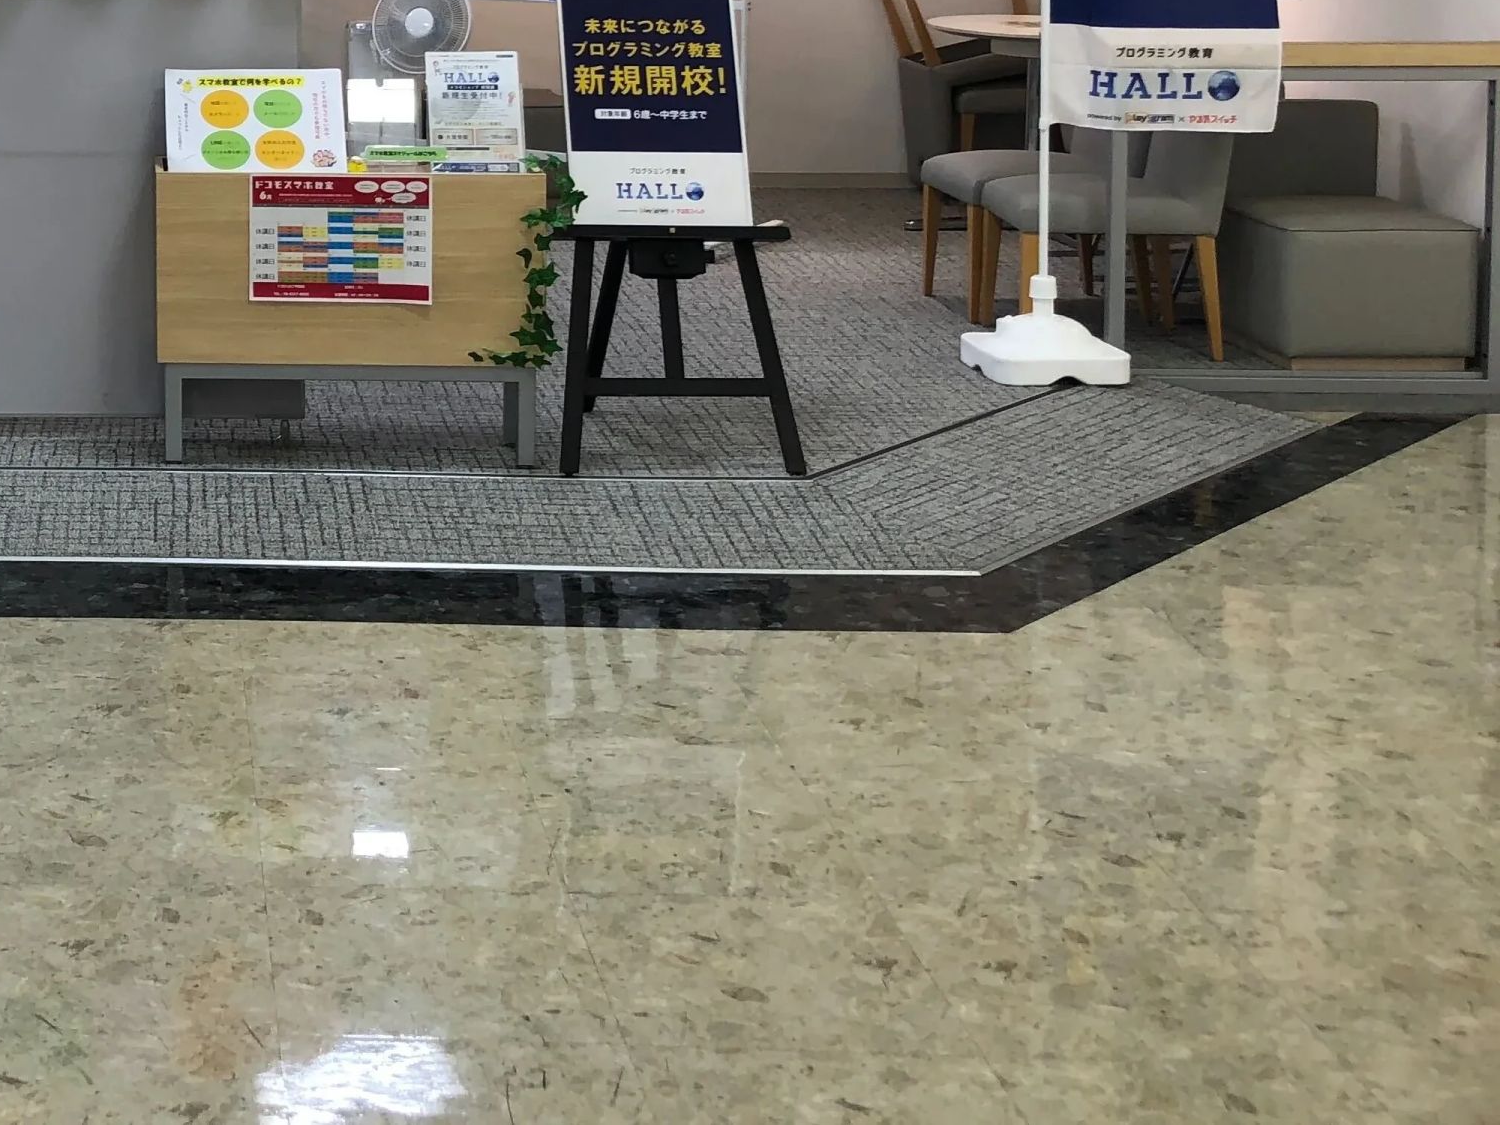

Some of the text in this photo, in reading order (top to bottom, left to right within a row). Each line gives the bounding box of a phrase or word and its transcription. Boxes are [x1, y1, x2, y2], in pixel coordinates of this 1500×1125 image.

[584, 19, 706, 35] 未来につながる
[572, 41, 722, 58] プログラミング教室
[1115, 47, 1214, 59] プログラミング教育
[573, 64, 727, 96] 新規開校!
[255, 180, 334, 190] ドコモスマホ教室
